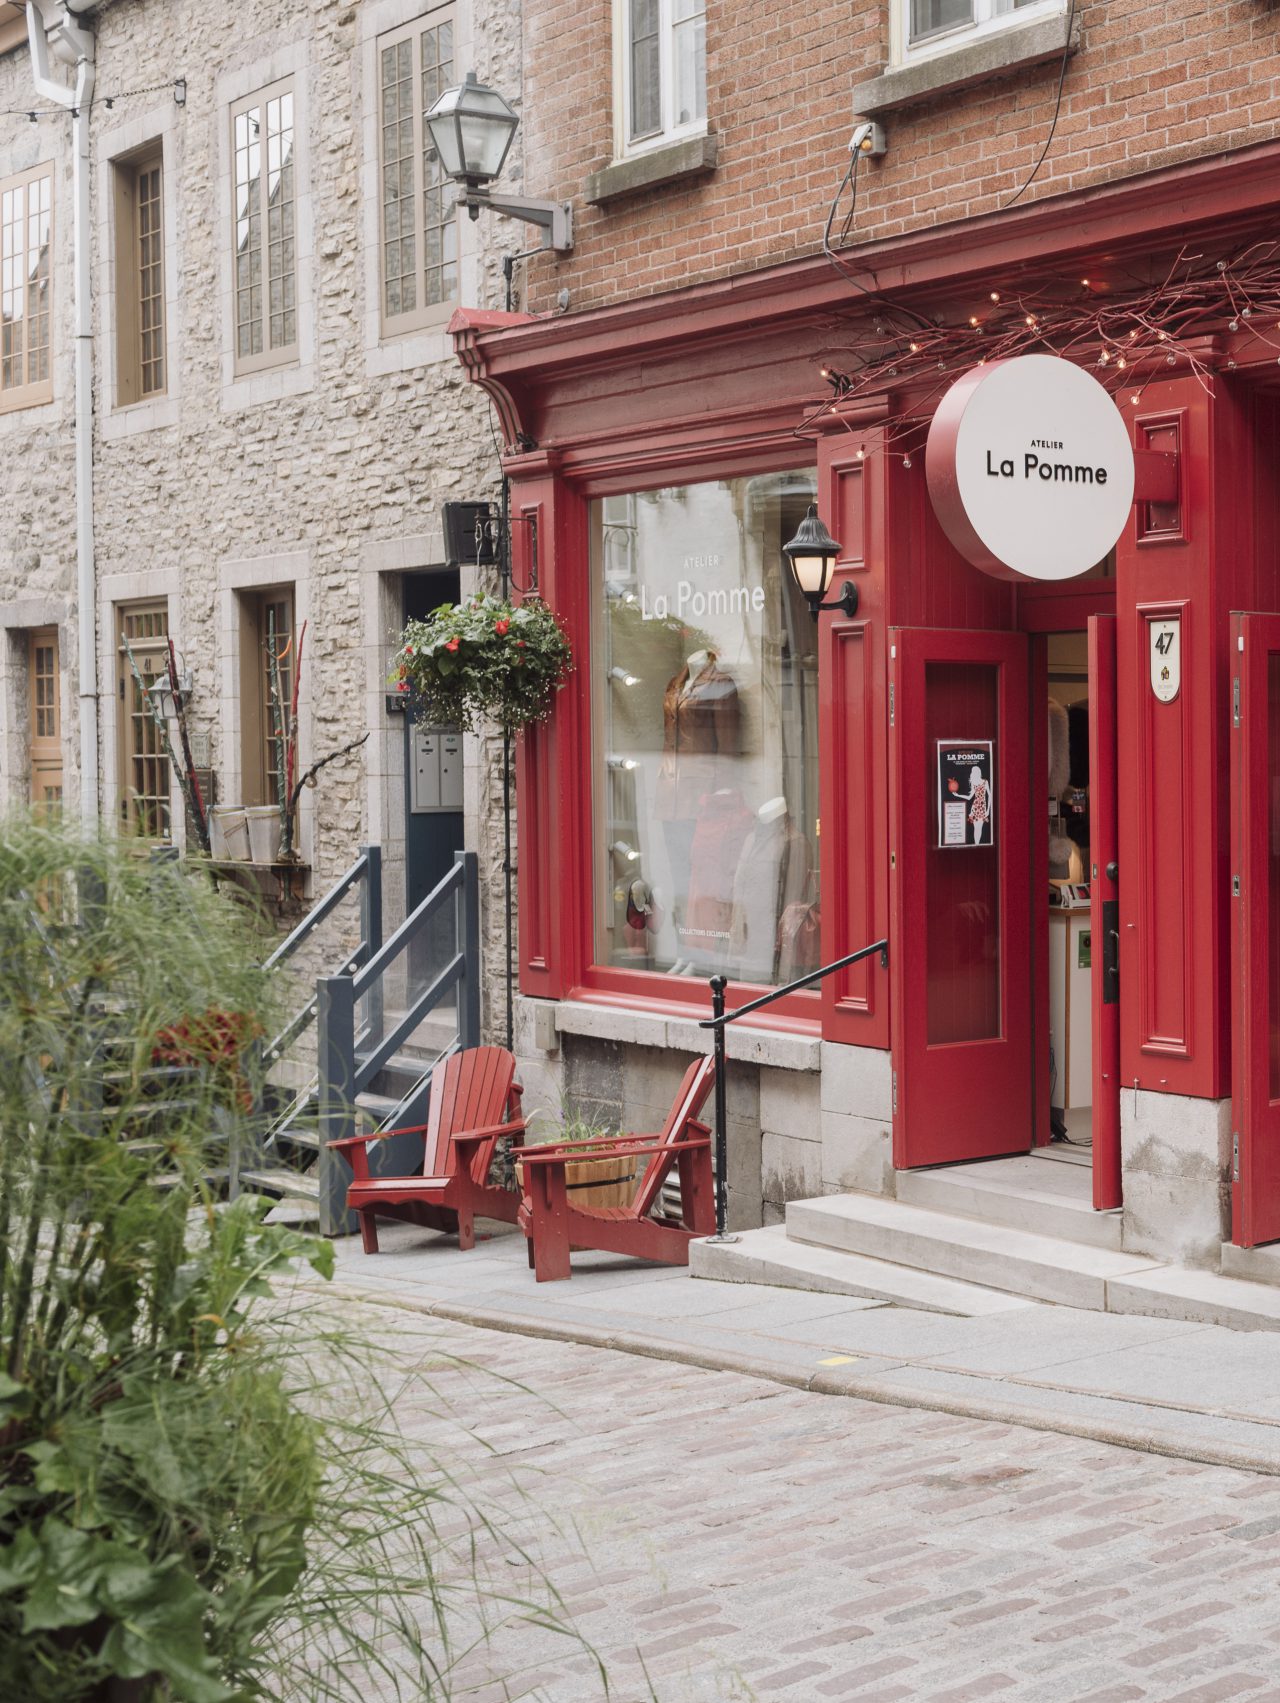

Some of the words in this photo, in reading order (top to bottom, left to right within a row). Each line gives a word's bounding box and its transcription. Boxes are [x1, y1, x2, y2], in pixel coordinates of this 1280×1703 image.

[1031, 440, 1064, 449] ATELIER
[987, 450, 1014, 477] La
[1024, 453, 1107, 485] Pomme
[684, 555, 719, 569] ATELIER
[642, 584, 667, 620] La
[678, 581, 765, 617] Pomme
[1155, 632, 1174, 655] 47
